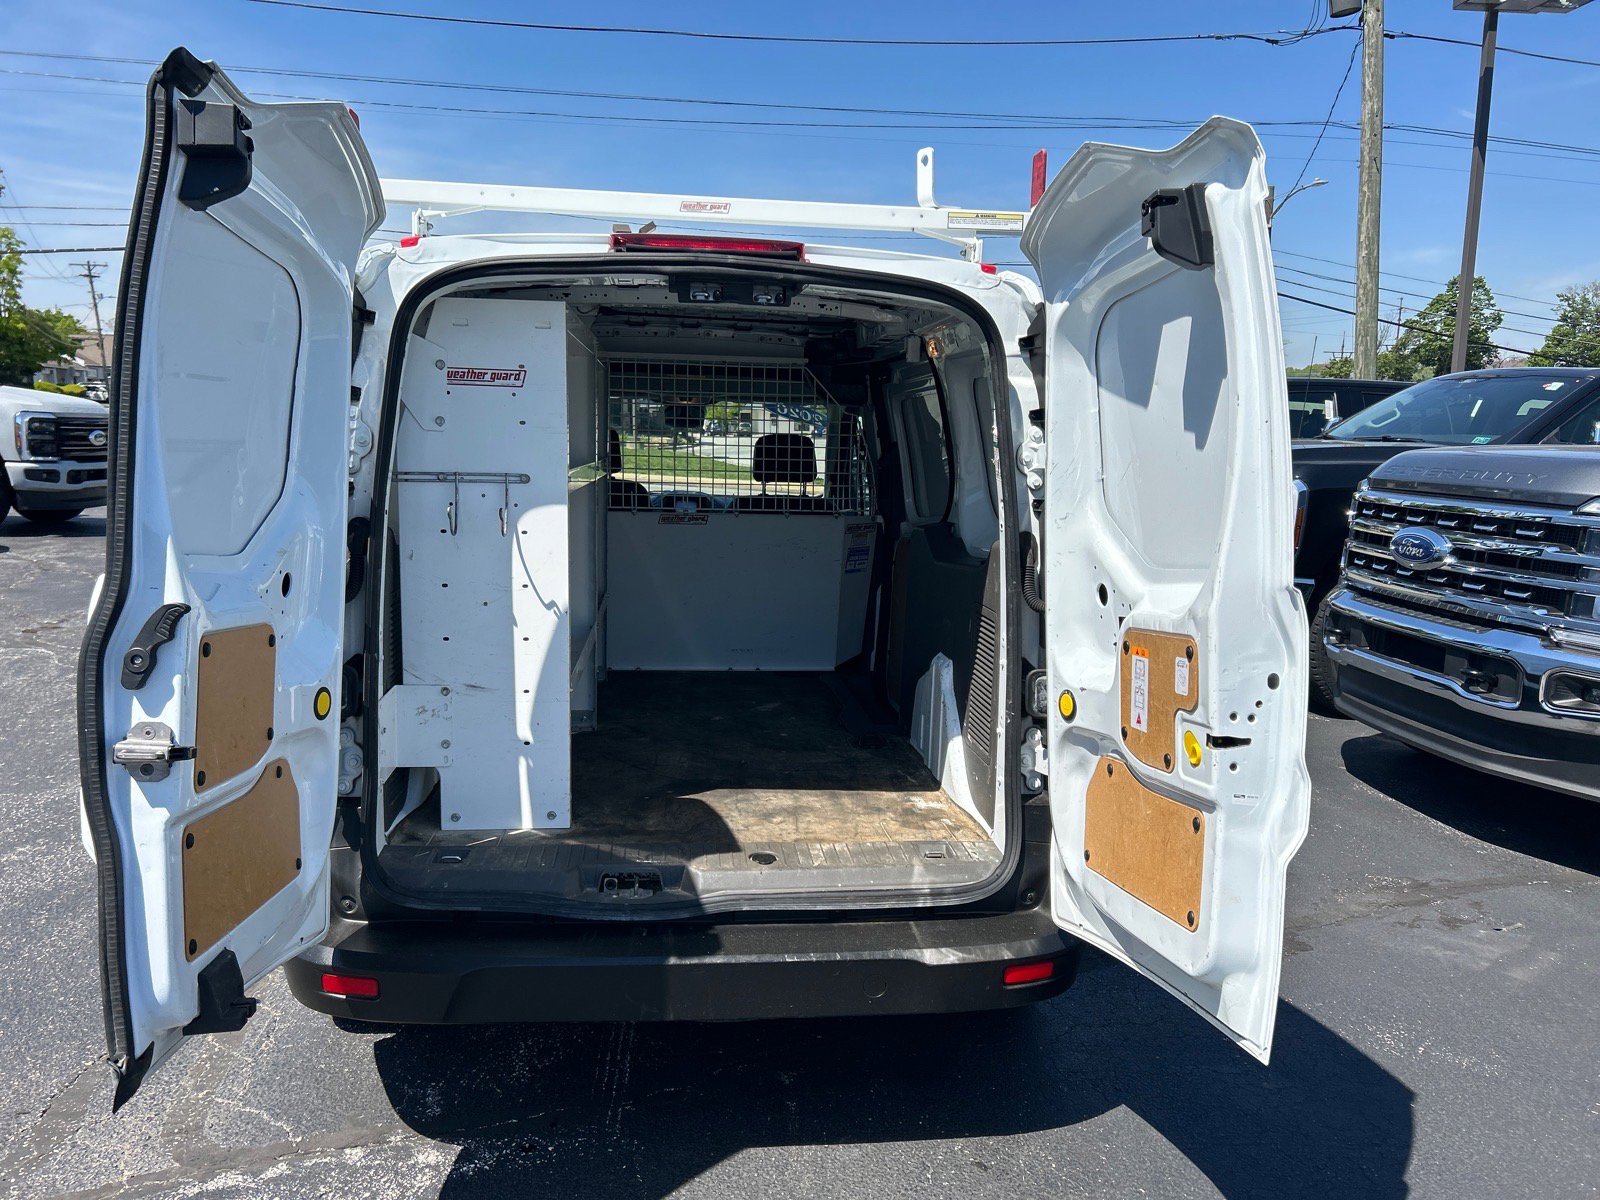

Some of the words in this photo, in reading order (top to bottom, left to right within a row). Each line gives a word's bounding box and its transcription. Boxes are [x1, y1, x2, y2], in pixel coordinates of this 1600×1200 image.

[682, 201, 709, 210] weather
[489, 371, 521, 383] guard
[1384, 466, 1455, 479] SUPER
[1459, 470, 1551, 485] DUTY
[1398, 537, 1425, 557] Ford
